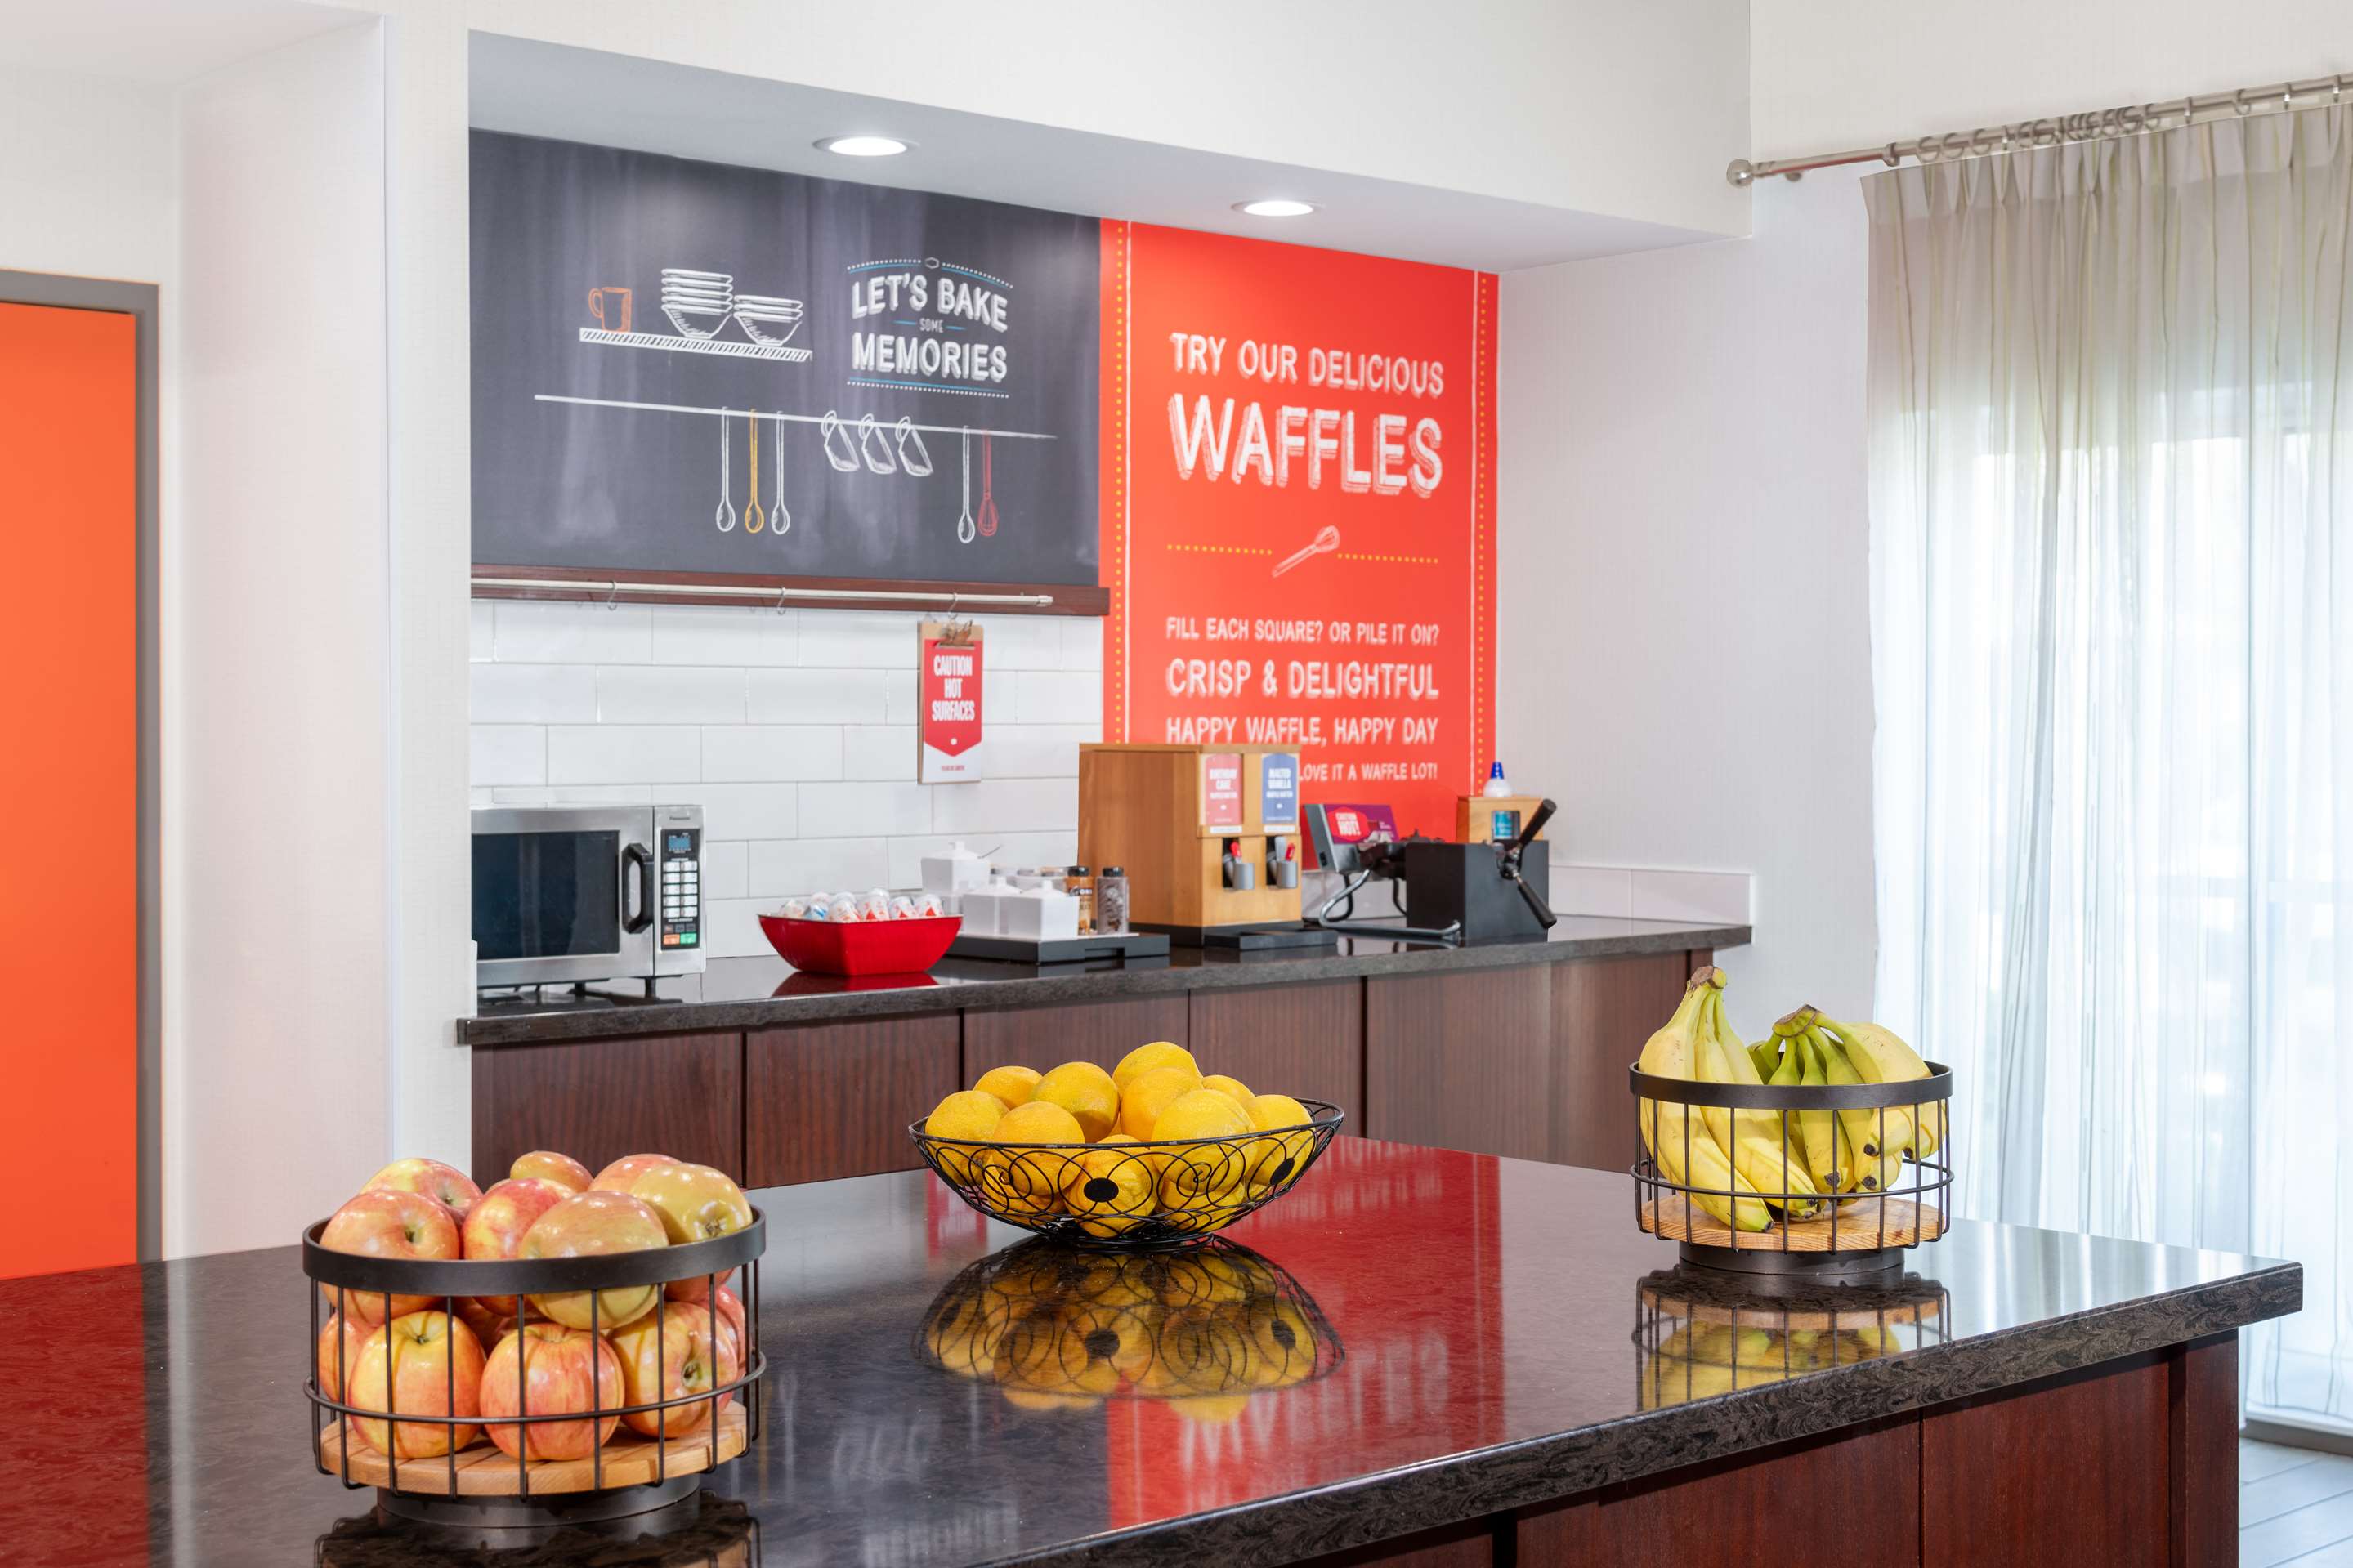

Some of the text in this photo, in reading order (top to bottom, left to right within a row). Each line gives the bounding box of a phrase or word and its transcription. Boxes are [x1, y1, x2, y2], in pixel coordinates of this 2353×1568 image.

[852, 273, 1008, 333] LET'S BAKE
[919, 318, 944, 333] SOME
[852, 332, 1008, 383] MEMORIES
[1169, 332, 1443, 399] TRY OUR DELICIOUS
[1167, 393, 1443, 499] WAFFLES
[1166, 617, 1439, 646] FILL EACH SQUARE? OR PILE IT ON?
[933, 655, 973, 677] CAUTION
[1165, 658, 1439, 701] CRISP & DELIGHTFUL
[944, 677, 963, 699] HOT
[932, 700, 975, 722] SURFACES
[1166, 717, 1438, 748] HAPPY WAFFLE, HAPPY DAY
[1331, 762, 1344, 782] IT
[1347, 762, 1358, 782] A
[1361, 762, 1407, 781] WAFFLE
[1411, 762, 1438, 780] LOT!
